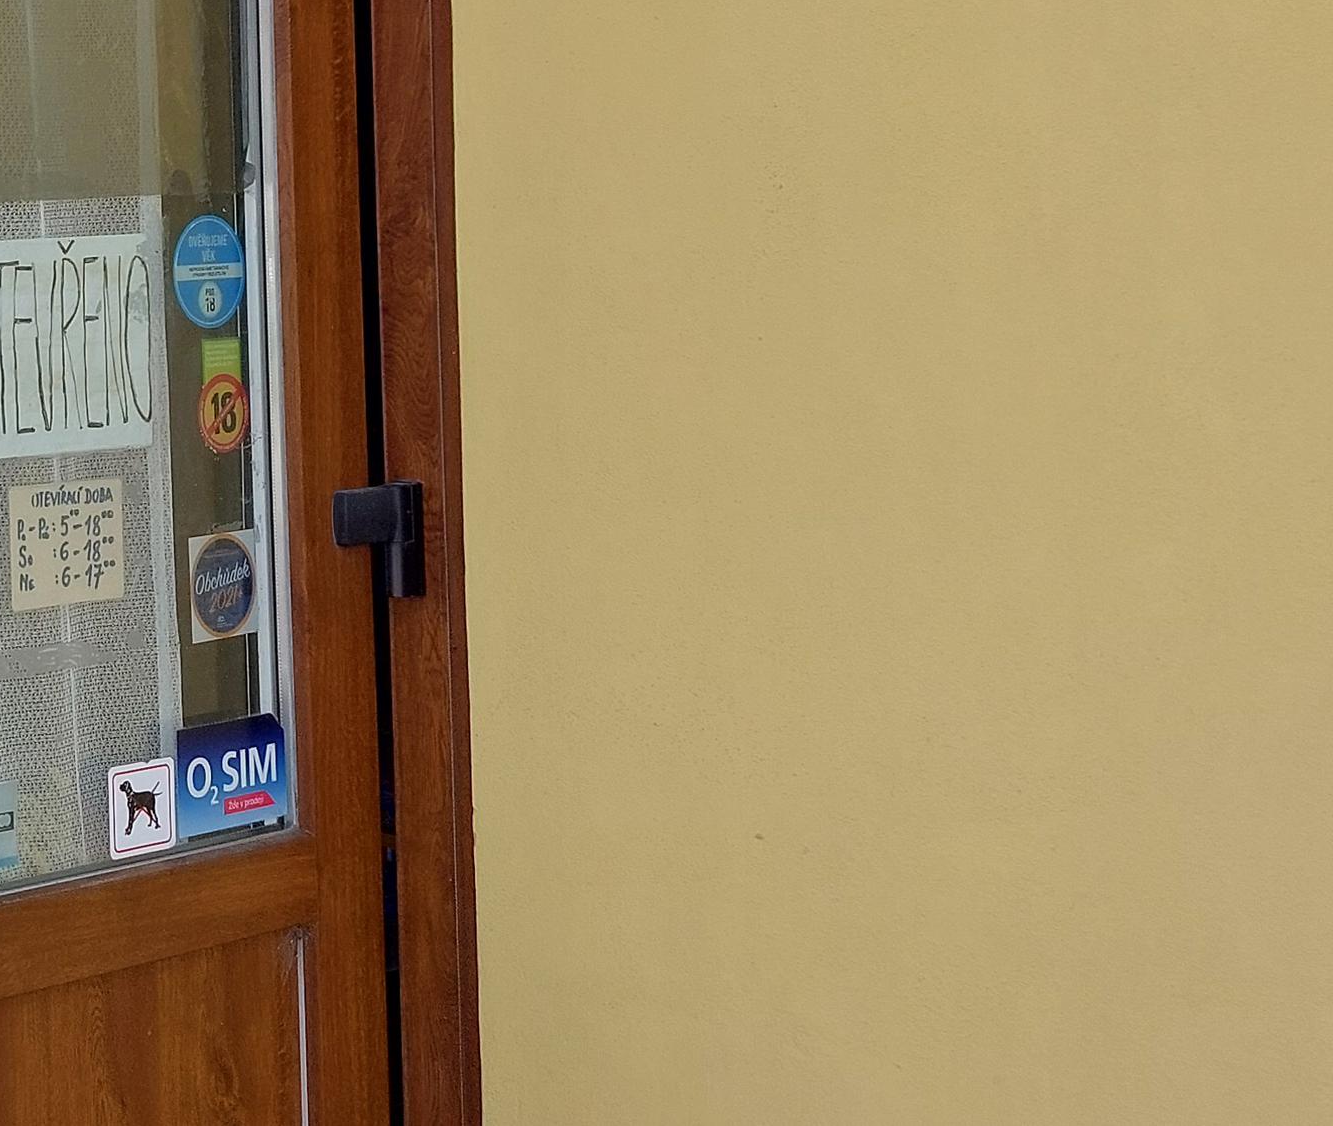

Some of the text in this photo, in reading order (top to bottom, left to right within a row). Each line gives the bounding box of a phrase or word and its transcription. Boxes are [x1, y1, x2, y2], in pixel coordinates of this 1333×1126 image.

[210, 391, 237, 435] 18
[84, 487, 114, 505] DOBA
[195, 557, 251, 595] Obchůdek
[221, 742, 277, 792] SIM
